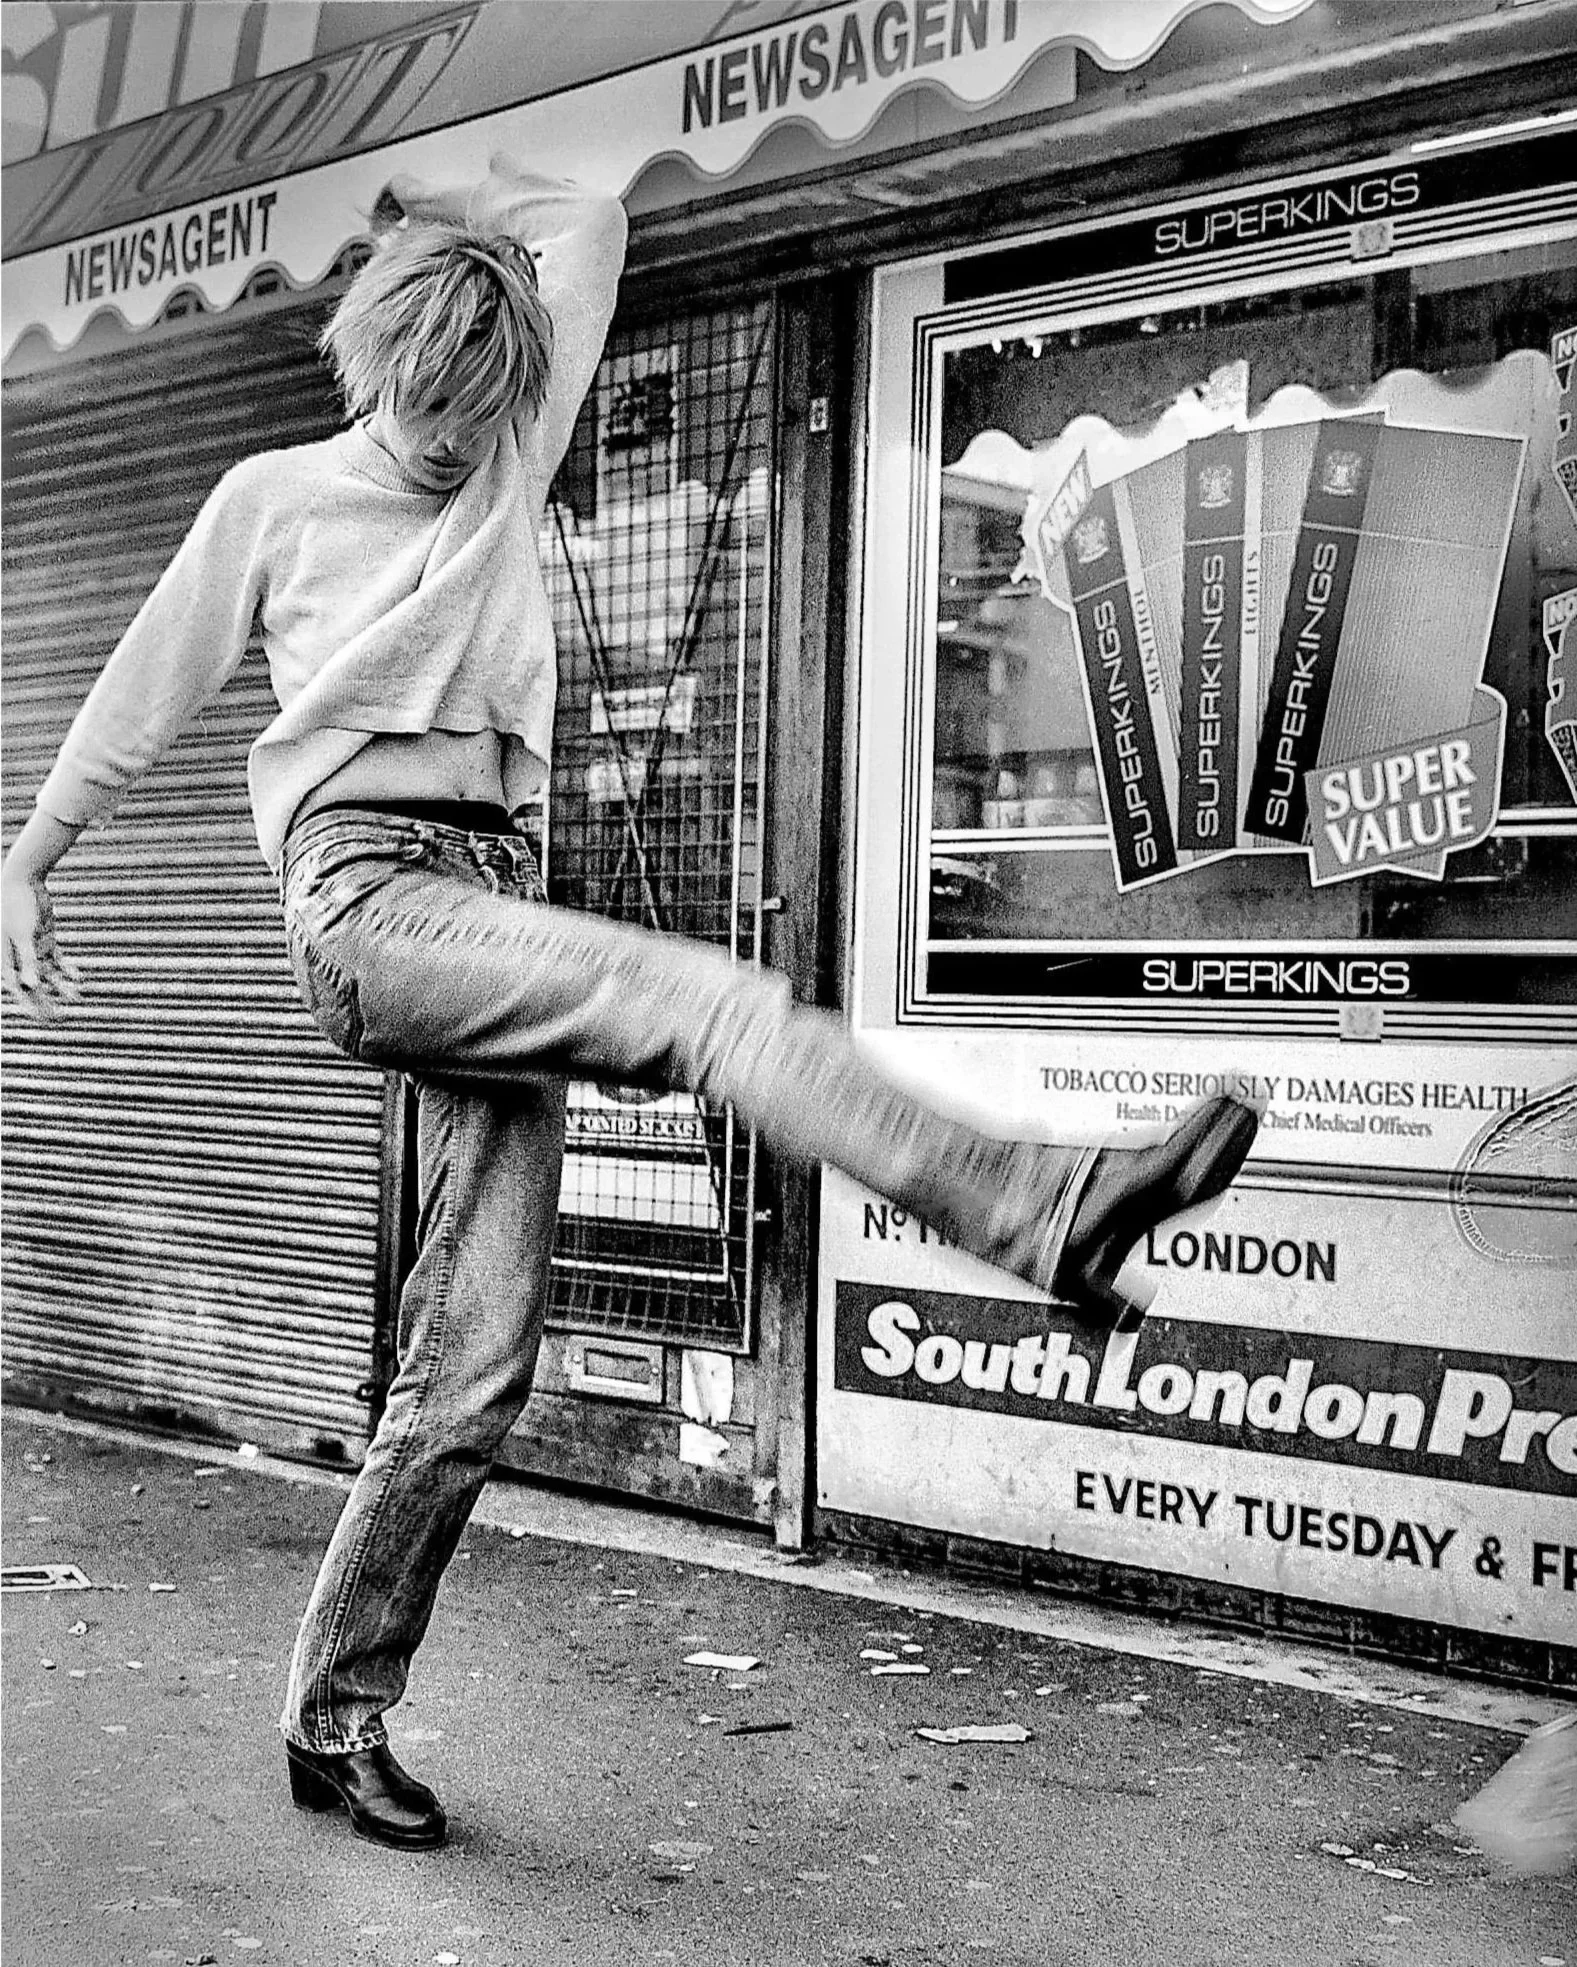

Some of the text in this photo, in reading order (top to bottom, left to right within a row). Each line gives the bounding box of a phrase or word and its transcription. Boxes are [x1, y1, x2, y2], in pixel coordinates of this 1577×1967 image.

[65, 191, 277, 306] NEWSAGENT
[1154, 170, 1422, 257] SUPERKINGS
[1196, 554, 1226, 839] SUPERKINGS
[1264, 541, 1340, 827] SUPERKINGS
[1092, 599, 1160, 869] SUPERKINGS
[1321, 739, 1477, 820] SUPER
[1325, 788, 1476, 865] VALUE
[1142, 958, 1411, 995] SUPERKINGS
[1040, 1066, 1528, 1112] TOBACCO SERIOUSLY DAMAGES HEALTH
[1304, 1112, 1366, 1133] Medical
[1369, 1114, 1433, 1137] Officers
[1146, 1228, 1337, 1283] LONDON
[860, 1302, 1091, 1404] South
[1093, 1332, 1426, 1451] London
[1076, 1470, 1218, 1528] EVERY
[1236, 1496, 1457, 1570] TUESDAY
[1475, 1536, 1504, 1580] &
